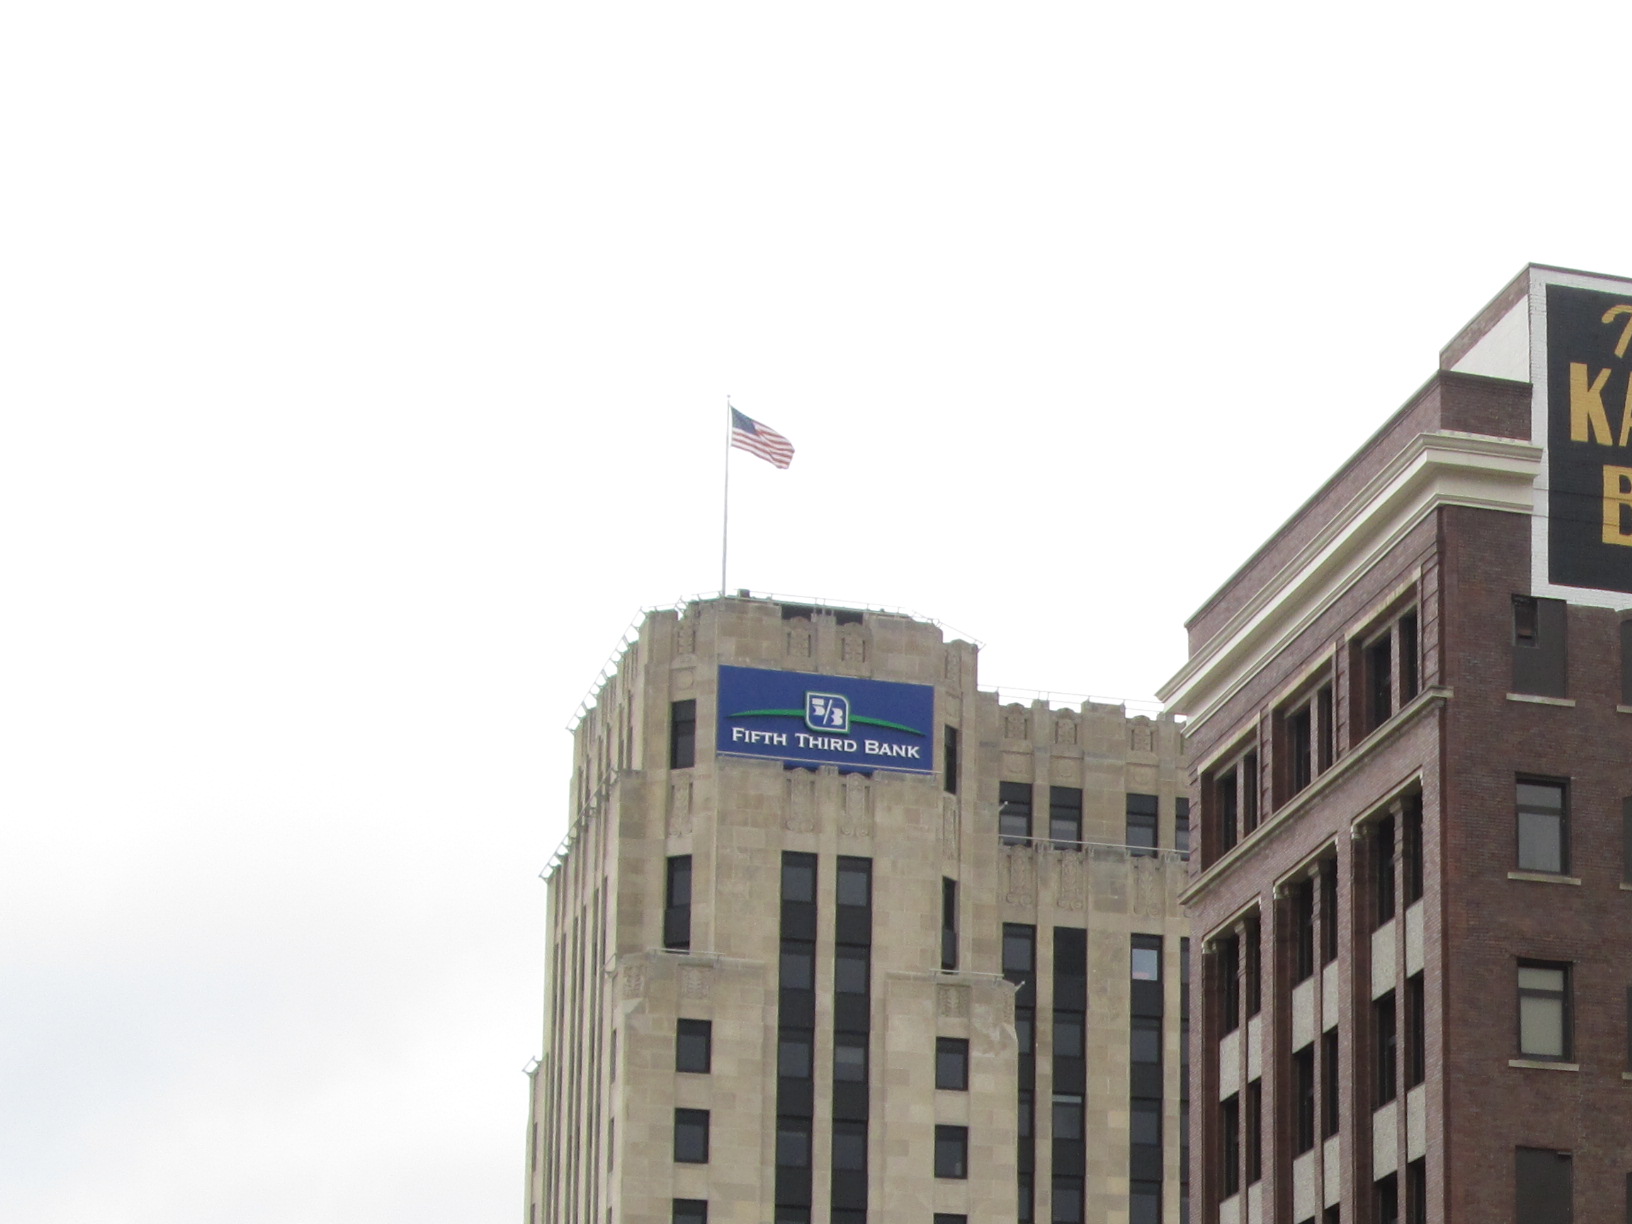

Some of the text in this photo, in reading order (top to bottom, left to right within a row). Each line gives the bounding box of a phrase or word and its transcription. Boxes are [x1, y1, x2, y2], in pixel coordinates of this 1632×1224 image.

[731, 726, 921, 759] FIFTH THIRD BANK
